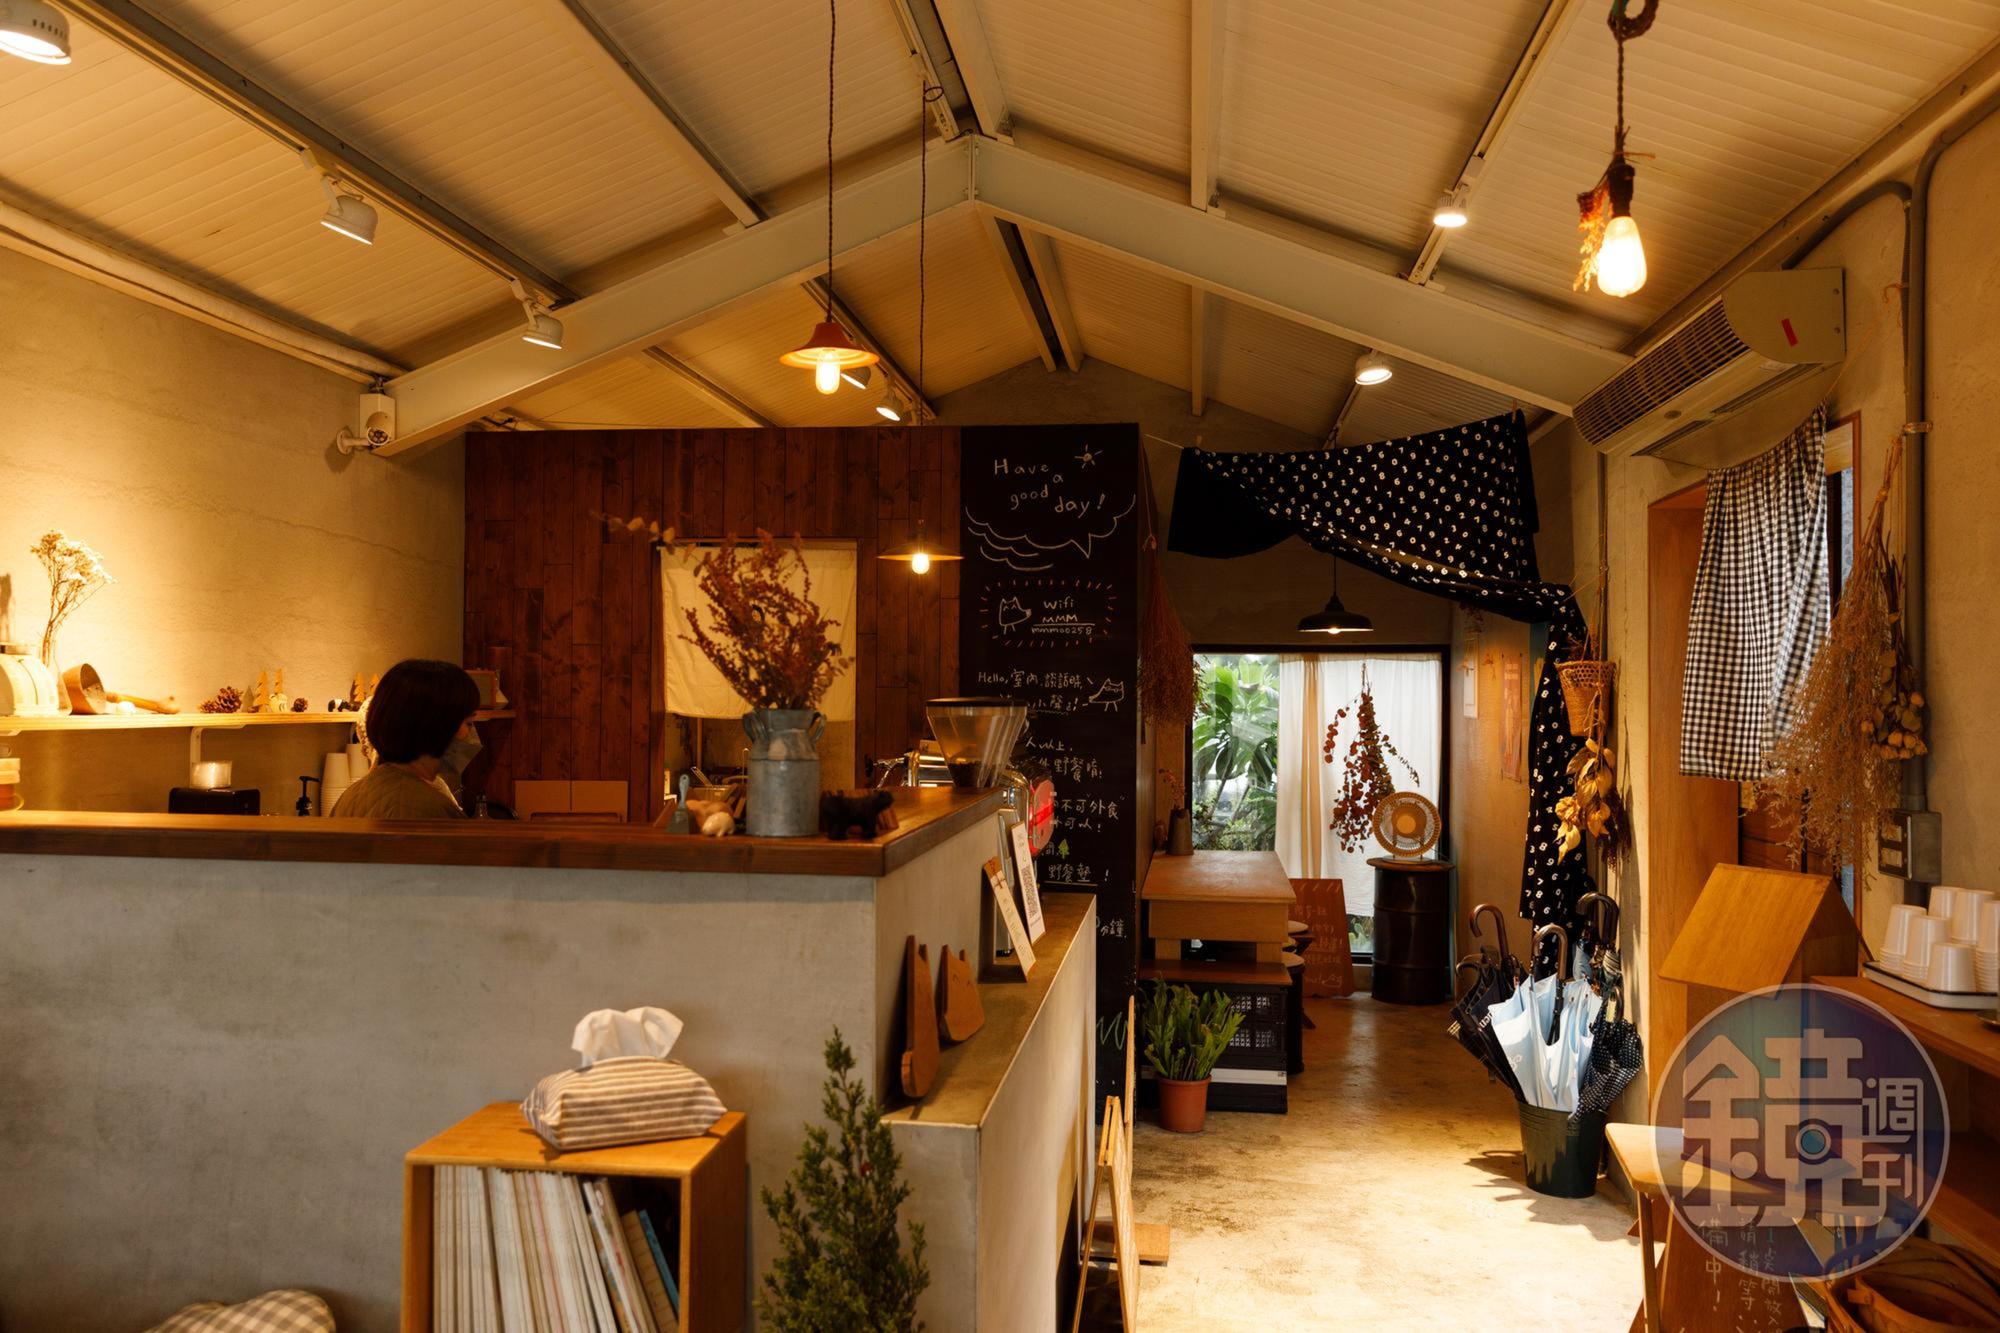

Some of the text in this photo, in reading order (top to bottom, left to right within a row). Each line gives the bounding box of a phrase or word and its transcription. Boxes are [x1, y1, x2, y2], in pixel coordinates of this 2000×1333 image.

[994, 458, 1064, 484] Have a
[1010, 484, 1049, 510] good
[977, 671, 1009, 684] Hello,
